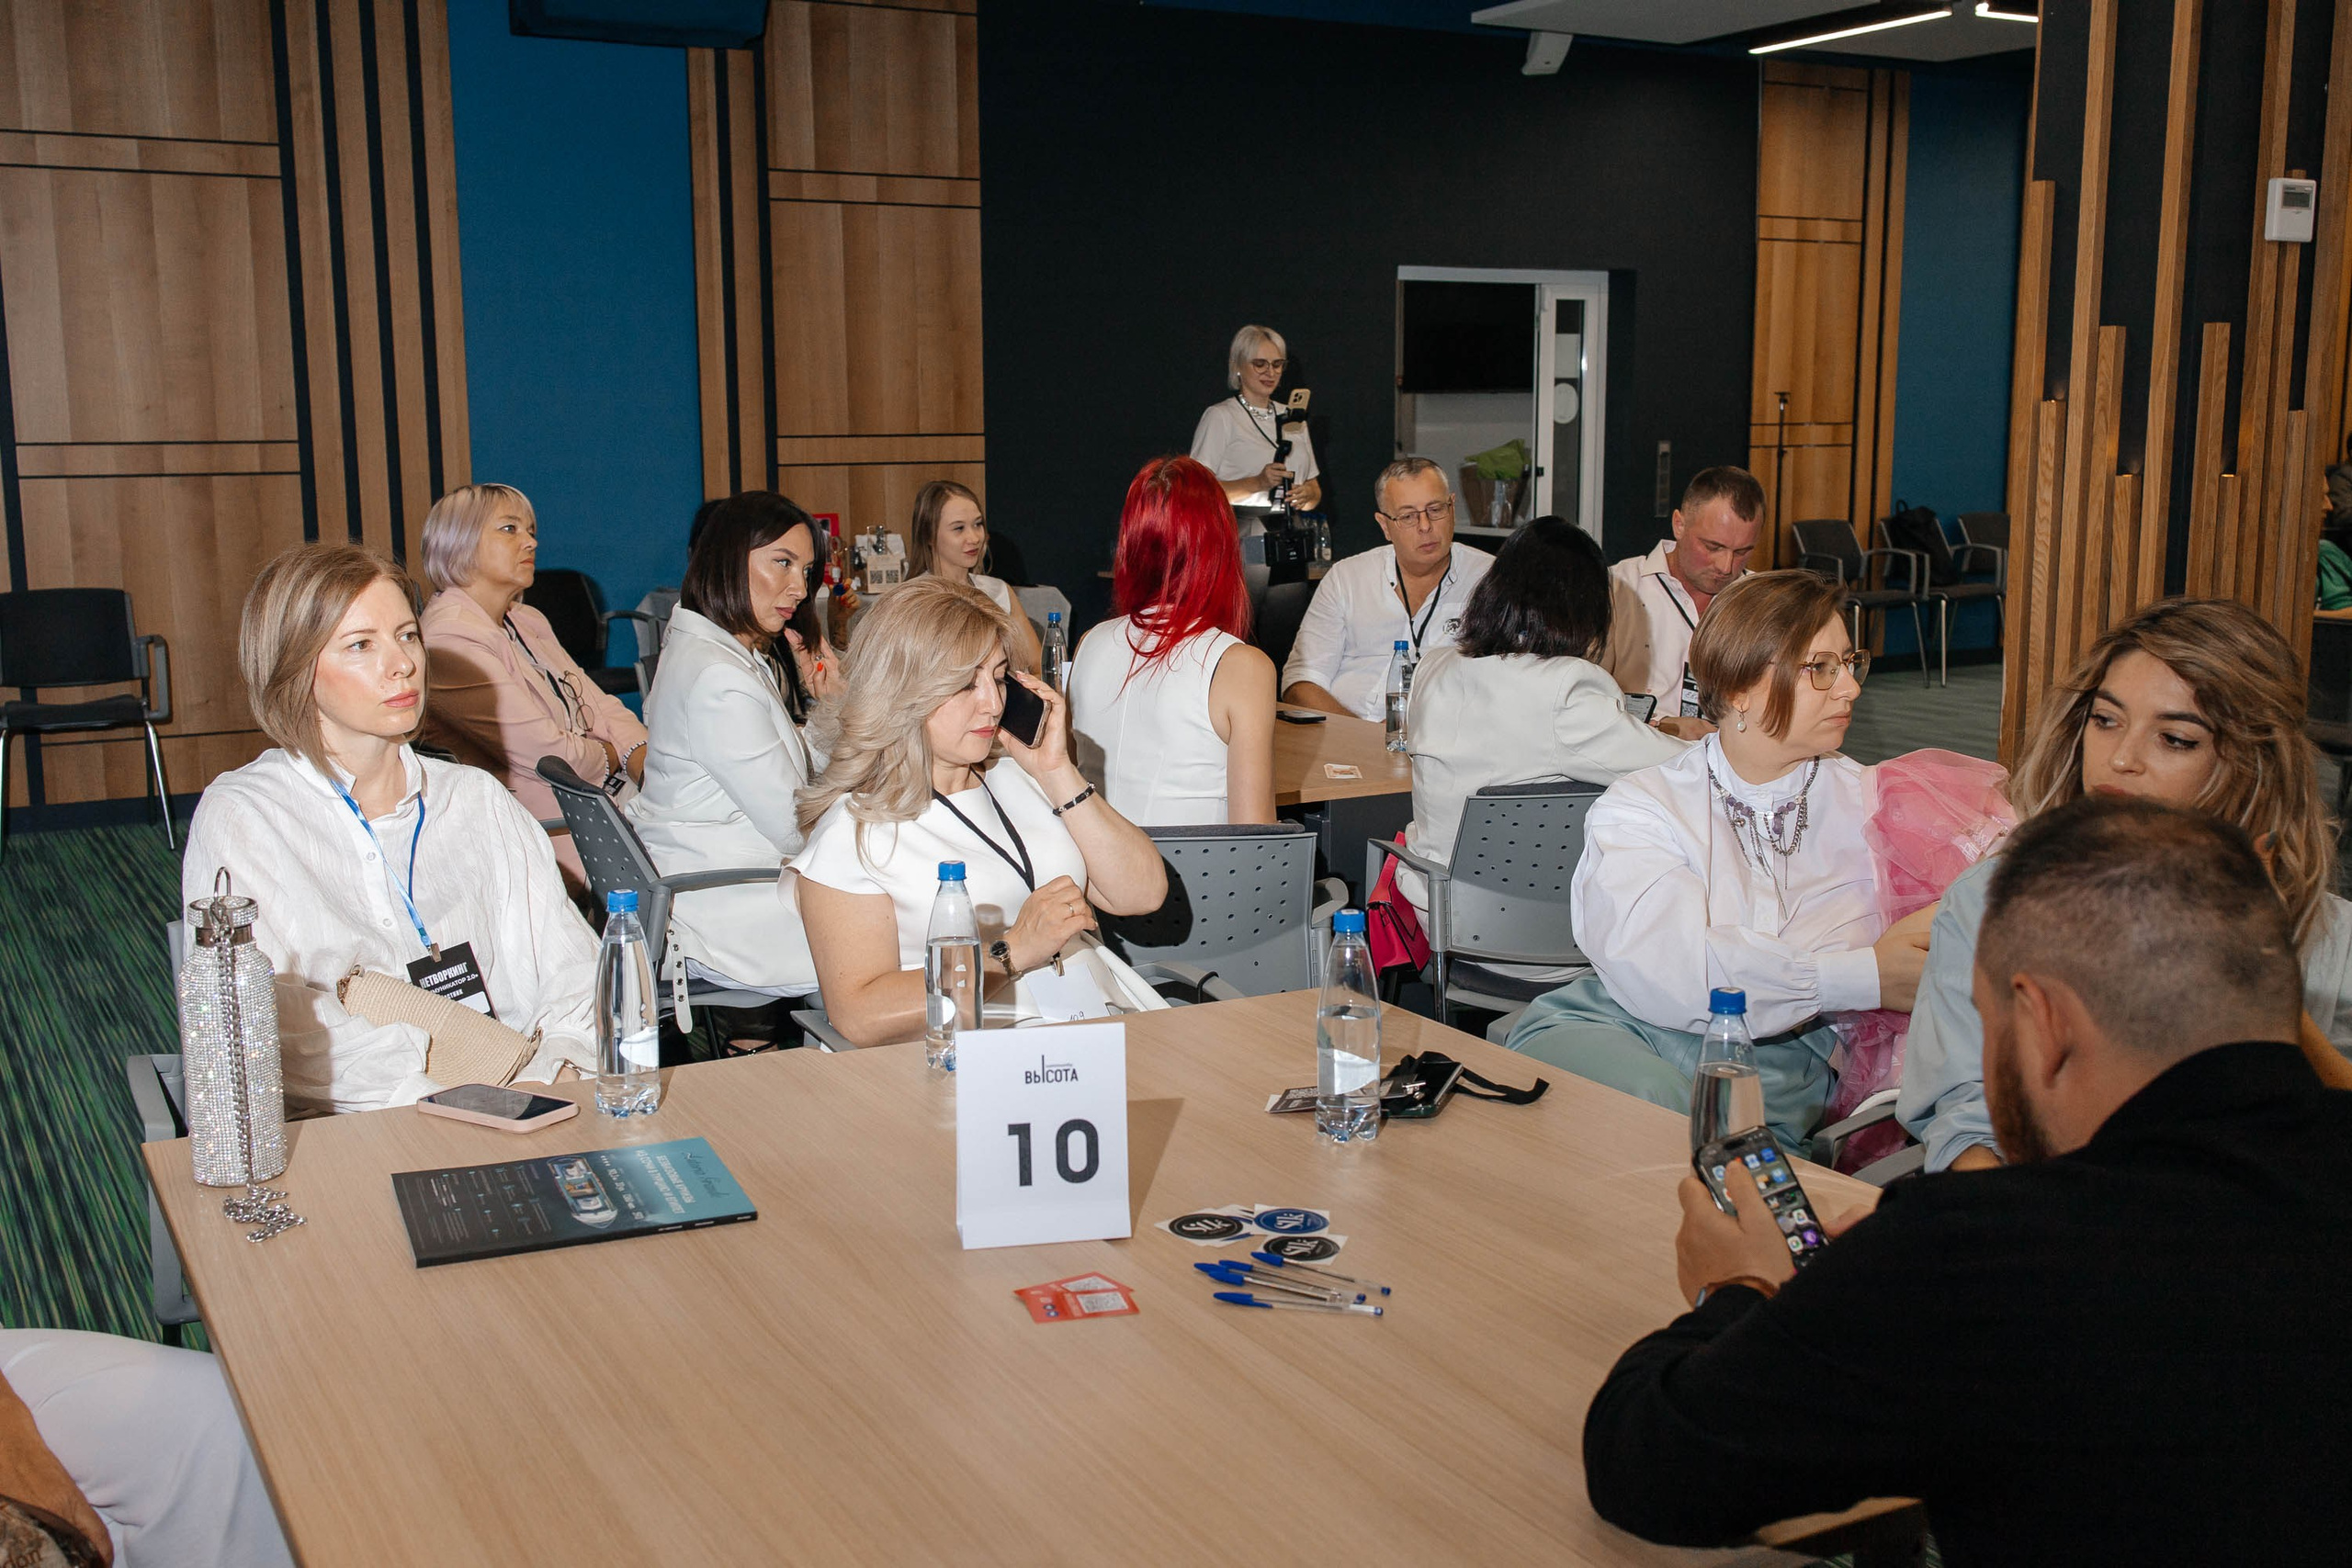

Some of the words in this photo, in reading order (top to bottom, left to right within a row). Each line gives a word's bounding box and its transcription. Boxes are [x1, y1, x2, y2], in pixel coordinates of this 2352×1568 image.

[419, 962, 469, 988] НЕТВОРКИНГ
[430, 977, 467, 994] МУНИКАТОР
[444, 988, 464, 999] АСТНИК
[1024, 1055, 1079, 1085] ВЫСОТА
[1008, 1118, 1100, 1187] 10
